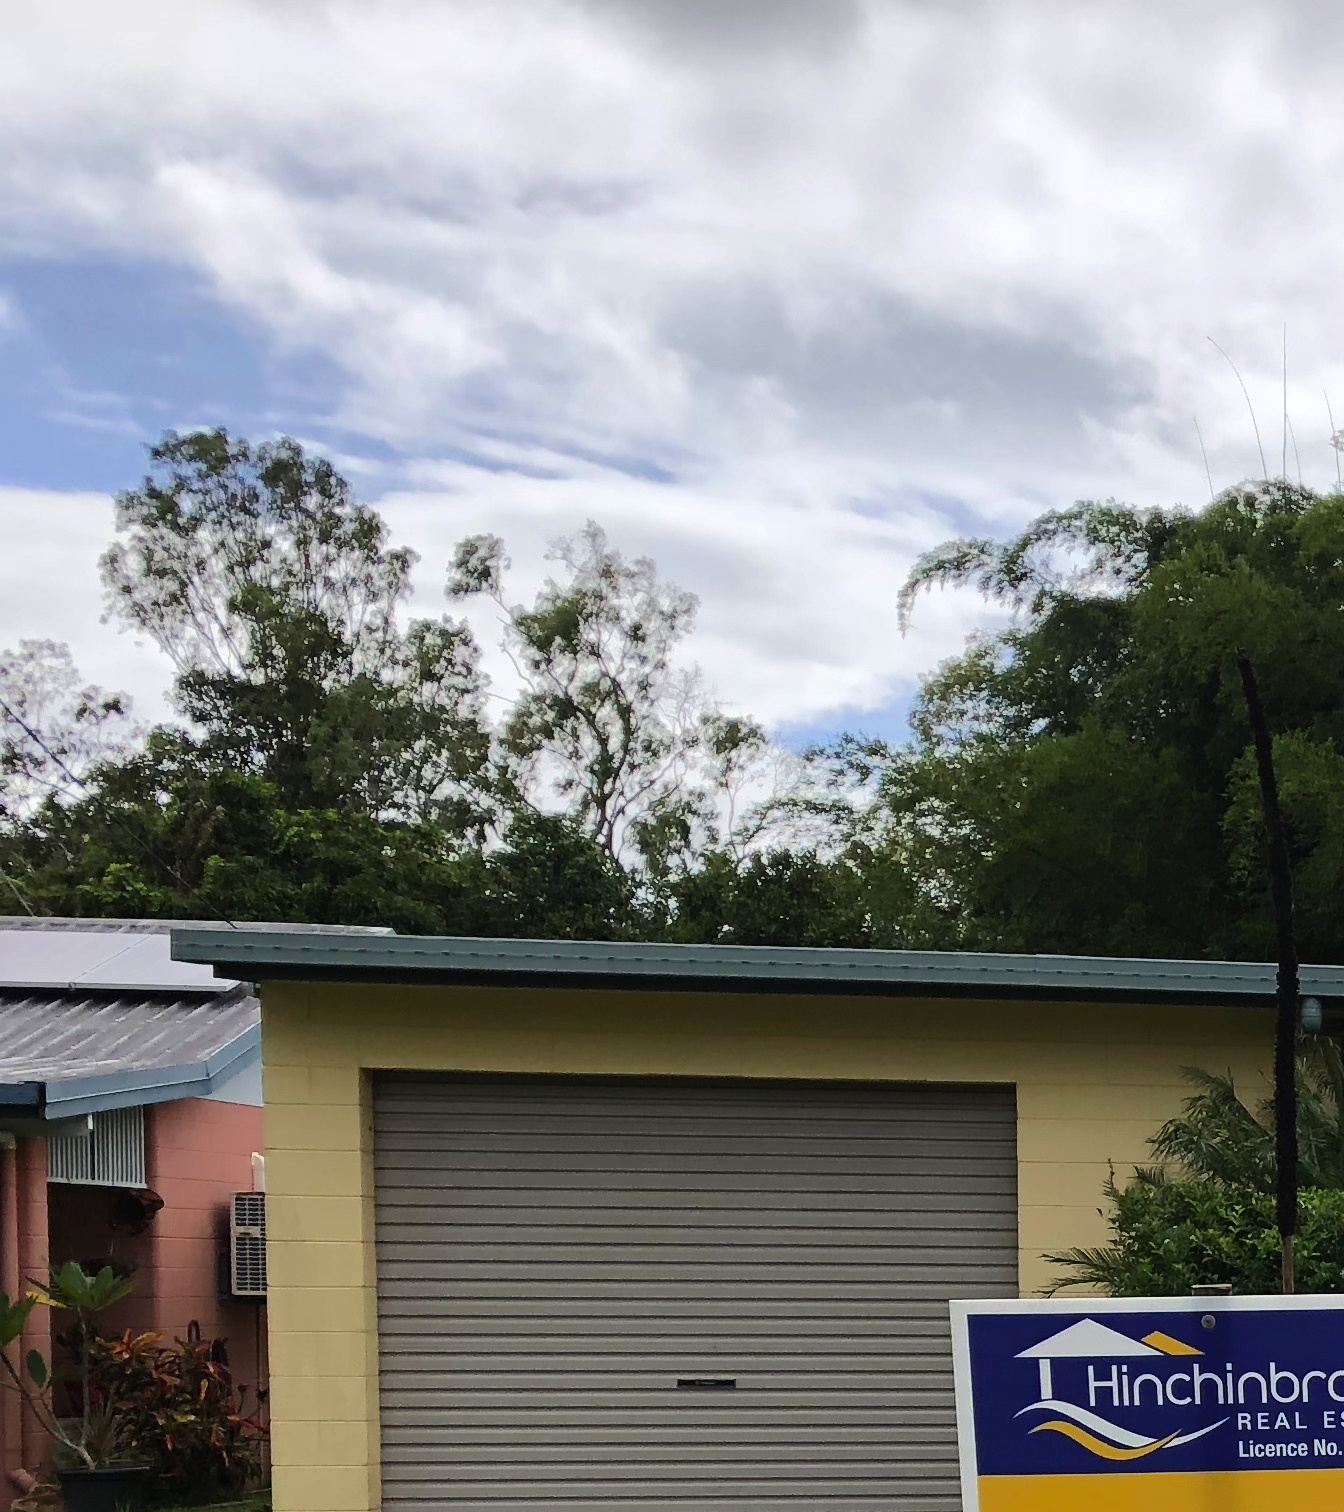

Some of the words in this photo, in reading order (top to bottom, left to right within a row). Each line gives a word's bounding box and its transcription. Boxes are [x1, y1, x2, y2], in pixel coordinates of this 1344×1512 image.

[1237, 1411, 1308, 1430] REAL
[1238, 1440, 1308, 1458] Licence
[1313, 1438, 1343, 1456] No.
